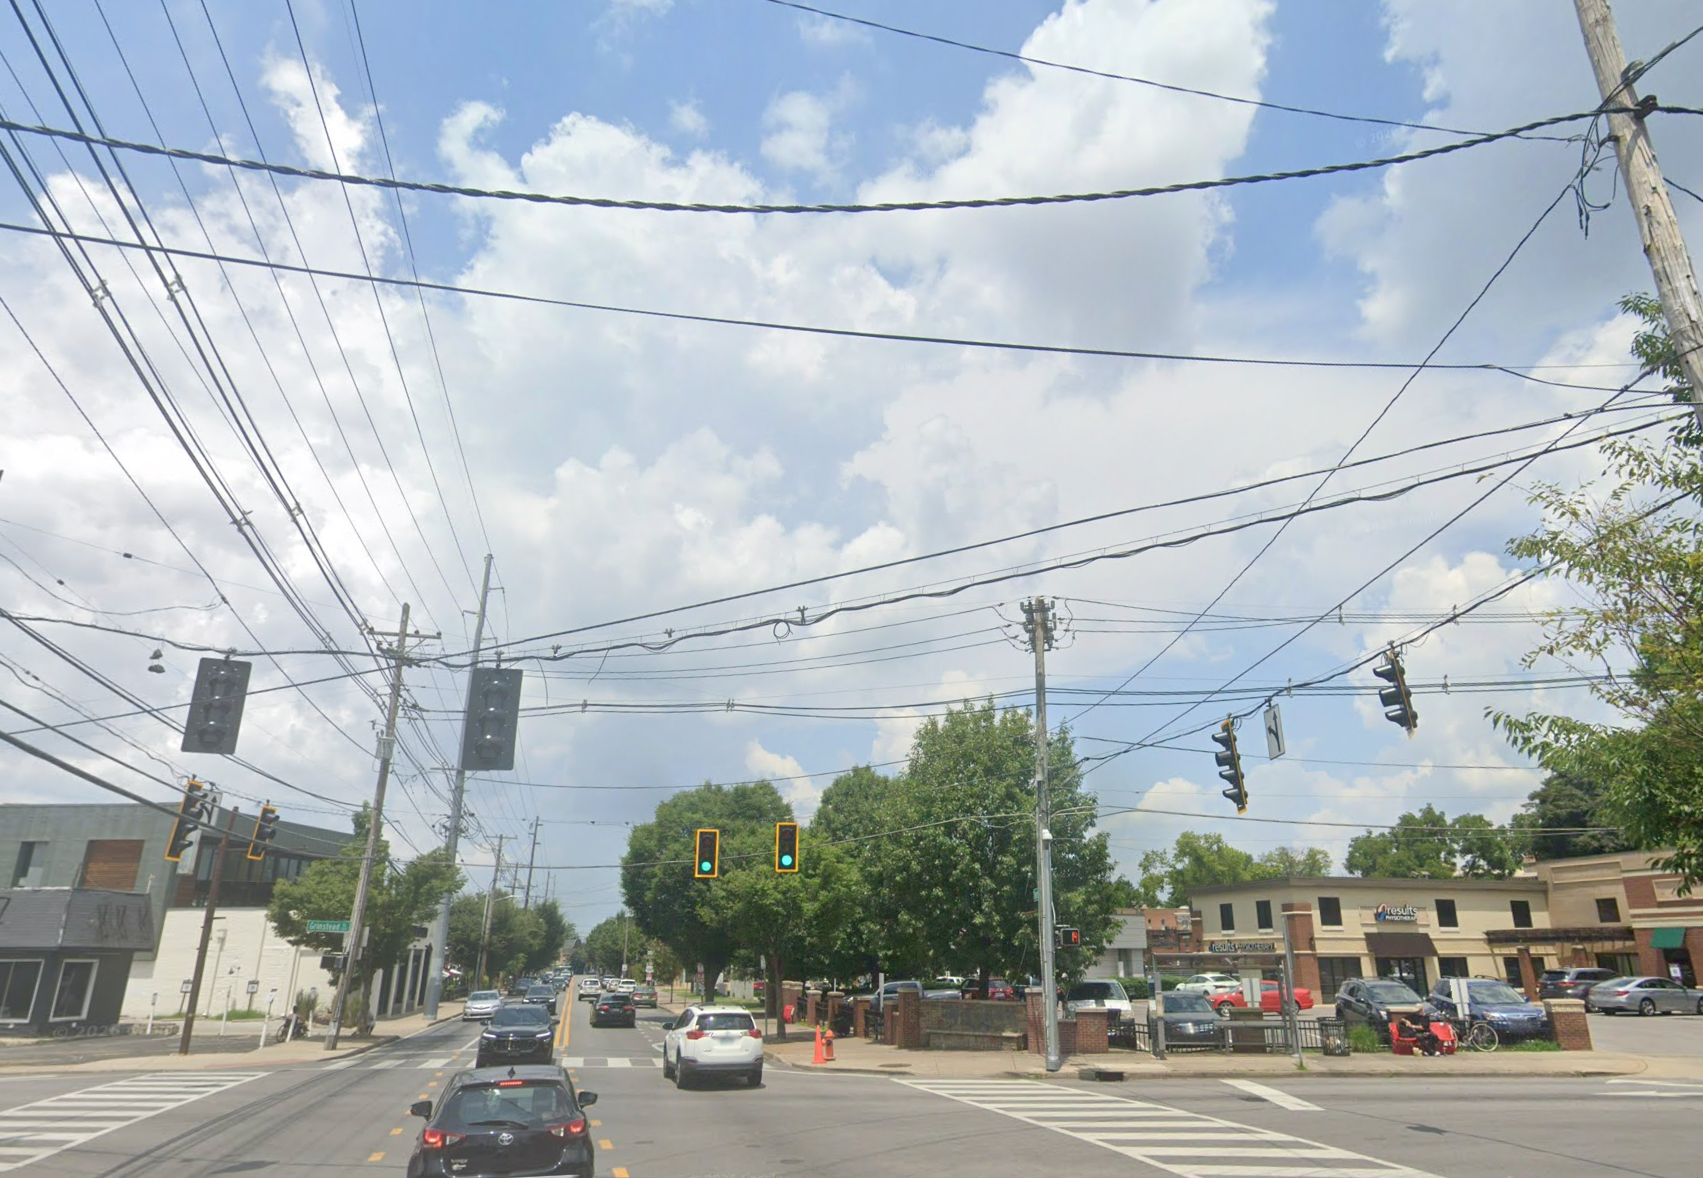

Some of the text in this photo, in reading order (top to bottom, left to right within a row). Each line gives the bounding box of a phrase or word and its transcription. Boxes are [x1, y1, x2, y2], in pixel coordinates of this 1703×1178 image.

[1387, 904, 1418, 915] results
[309, 921, 340, 931] Grinstead
[1212, 940, 1235, 952] results
